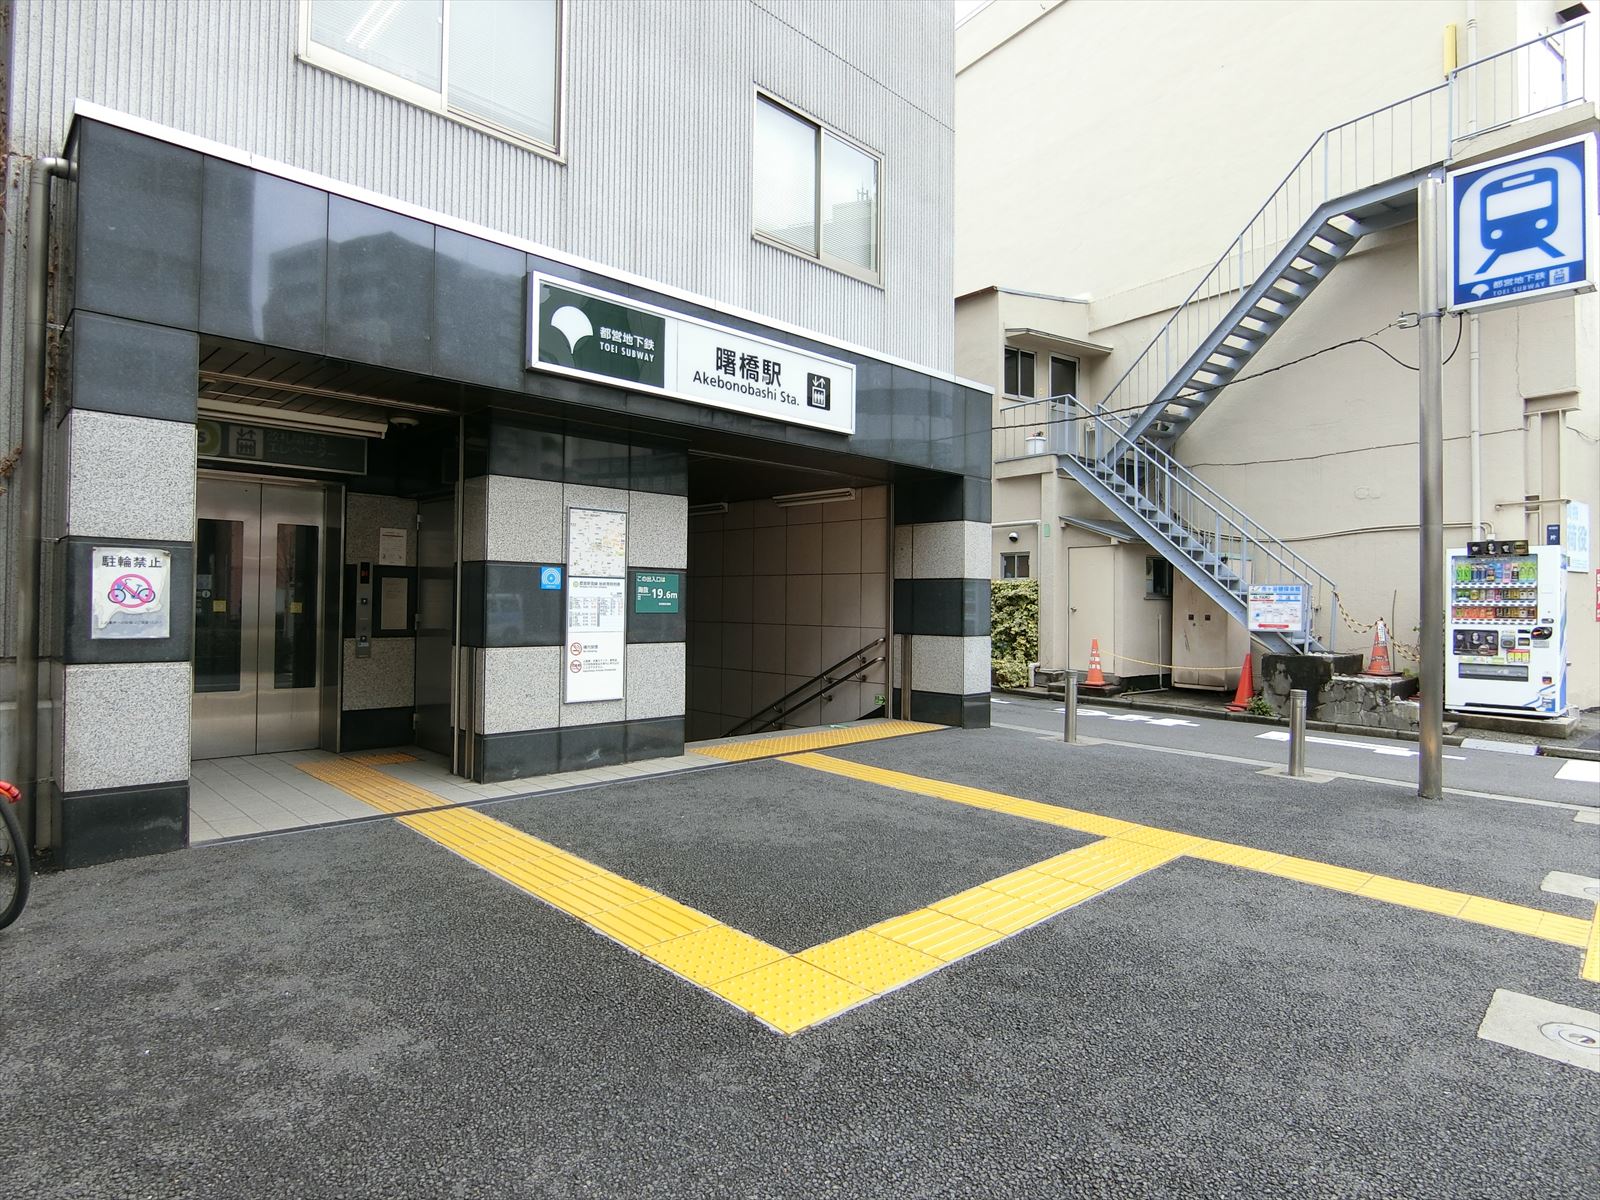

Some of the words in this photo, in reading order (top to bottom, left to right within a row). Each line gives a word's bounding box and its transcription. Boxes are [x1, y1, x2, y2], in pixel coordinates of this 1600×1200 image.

[1493, 271, 1545, 288] 都営地下鉄
[1493, 288, 1510, 296] TOEI
[1512, 281, 1545, 292] SUBWAY
[599, 326, 655, 351] 都営地下鉄
[599, 342, 618, 354] TOEI
[621, 346, 655, 363] SUBWAY
[715, 346, 782, 387] 曙橋駅
[693, 371, 777, 401] Akebonobashi
[780, 391, 800, 406] Sta.
[101, 555, 163, 569] 駐輪禁止
[651, 588, 678, 600] 19.6m
